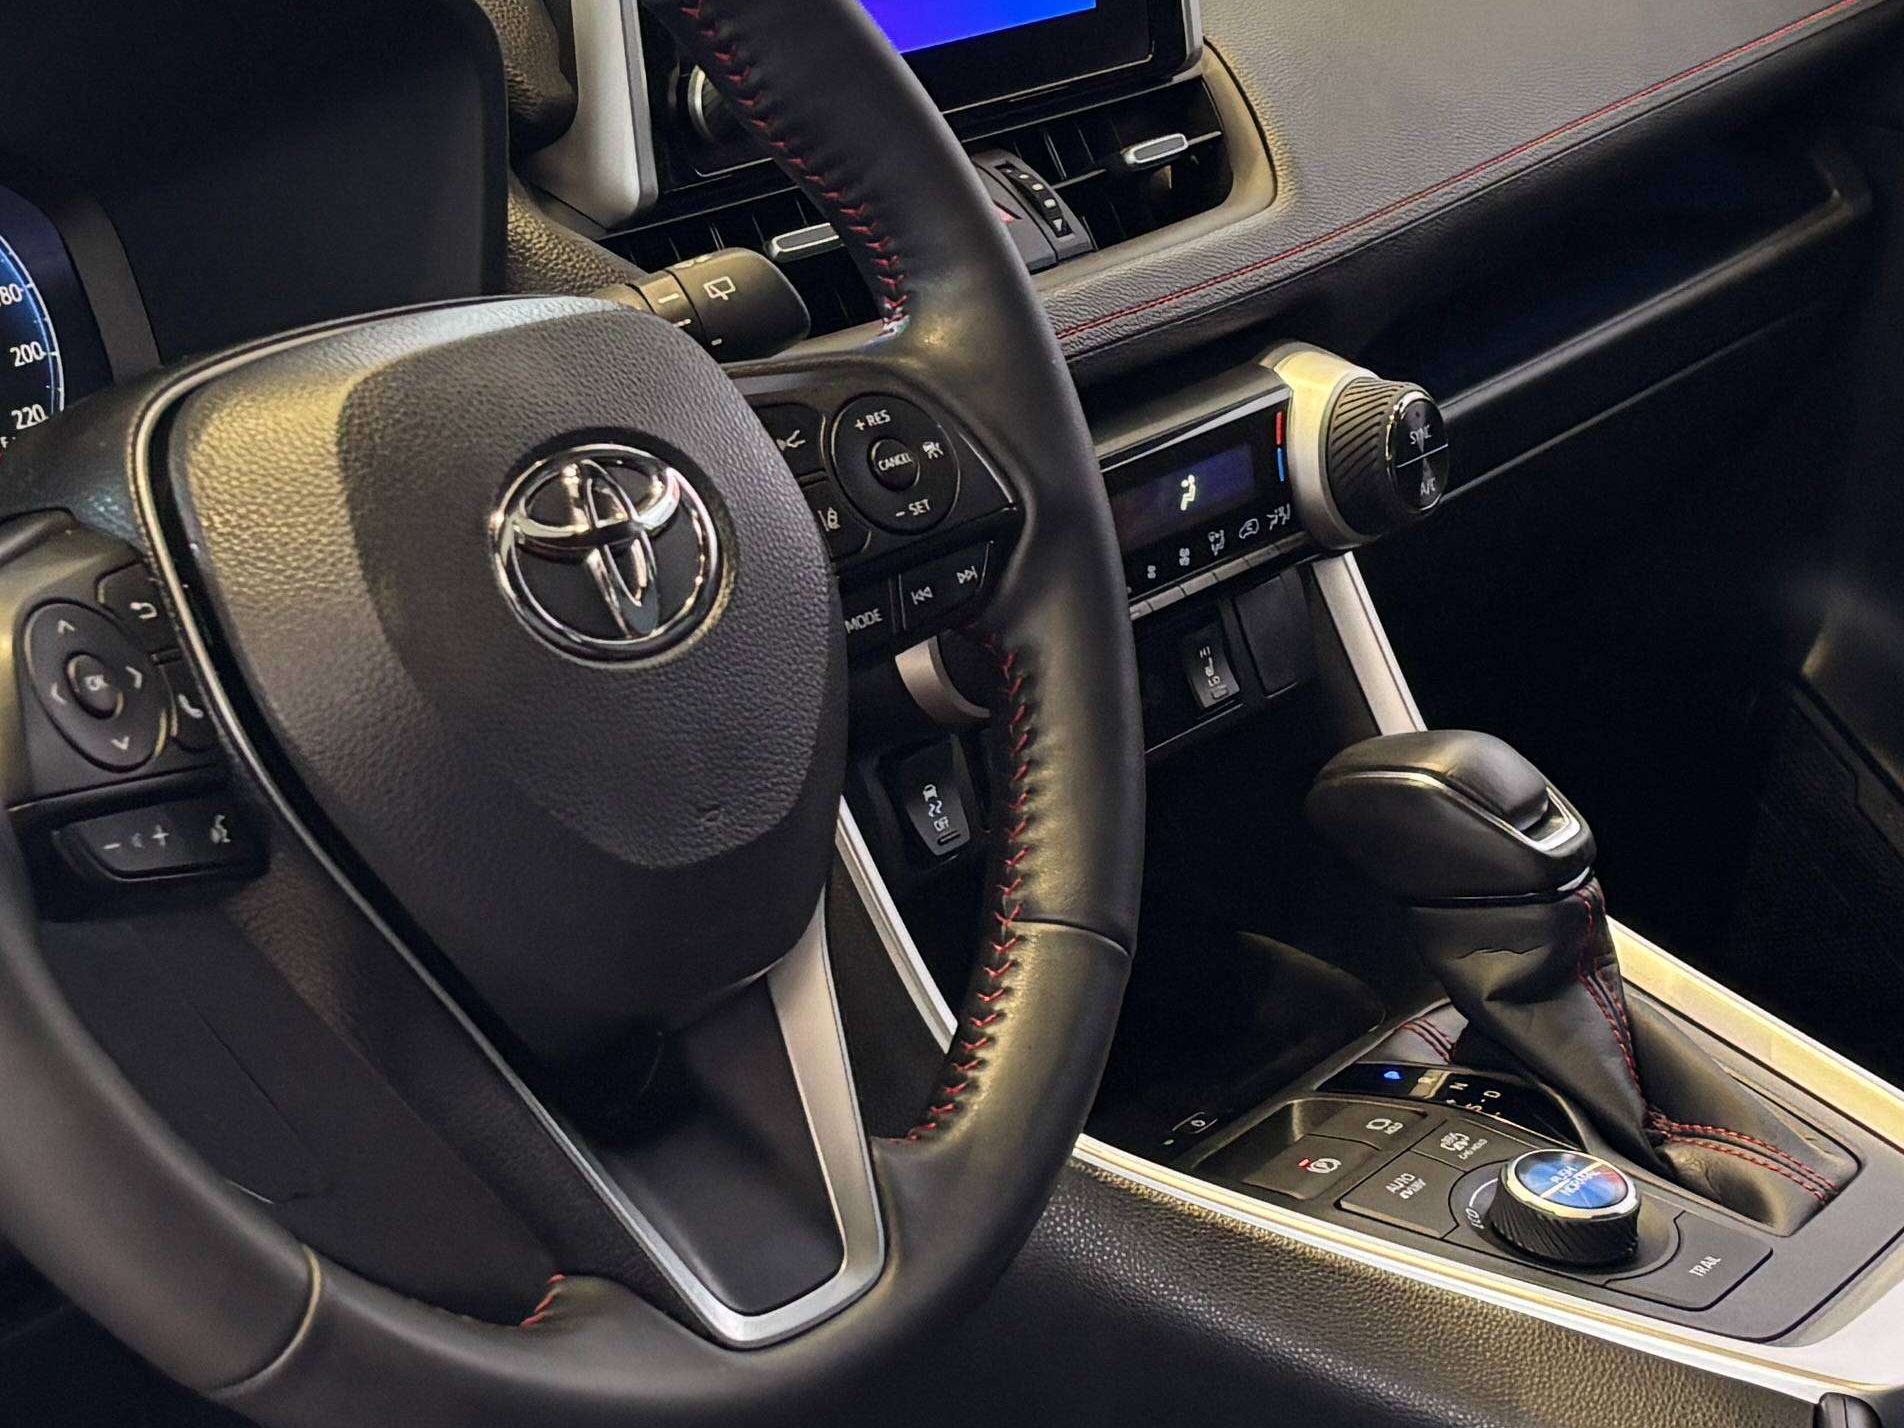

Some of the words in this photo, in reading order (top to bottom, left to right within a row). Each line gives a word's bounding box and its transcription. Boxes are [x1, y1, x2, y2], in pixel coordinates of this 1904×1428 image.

[9, 341, 46, 367] 200
[11, 404, 48, 430] 220
[0, 436, 9, 449] F
[878, 453, 913, 471] CANCEL
[1420, 477, 1436, 496] A/C
[845, 607, 883, 634] MODE
[933, 816, 950, 832] OFF
[1385, 1173, 1416, 1195] AUTO
[1689, 1256, 1721, 1278] TRAIL
